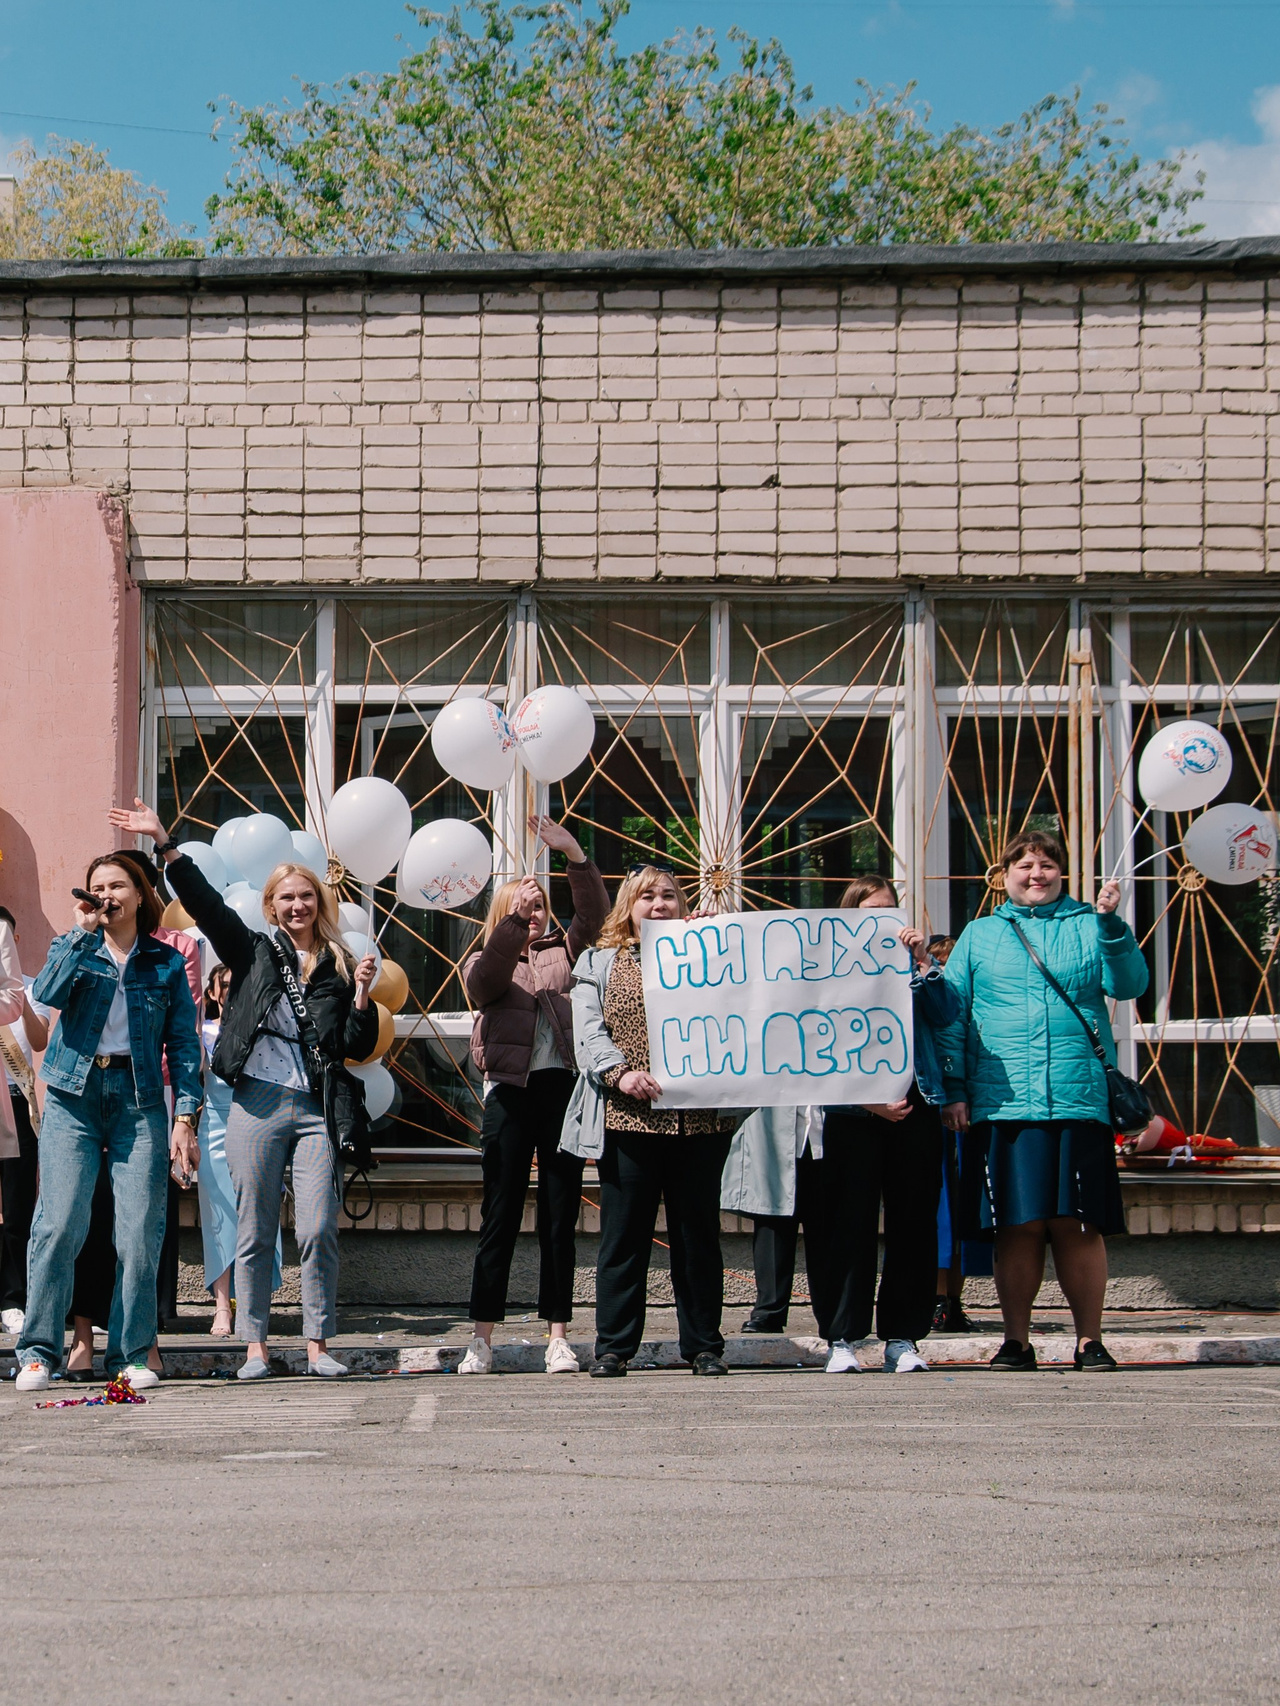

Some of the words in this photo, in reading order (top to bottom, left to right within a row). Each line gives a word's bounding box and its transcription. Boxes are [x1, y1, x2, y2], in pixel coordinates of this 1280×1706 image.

[655, 923, 747, 990] НИ
[762, 915, 912, 982] ПУХА
[280, 965, 307, 1018] GUESS
[661, 1014, 748, 1078] НИ
[761, 1007, 909, 1077] ПЕРА
